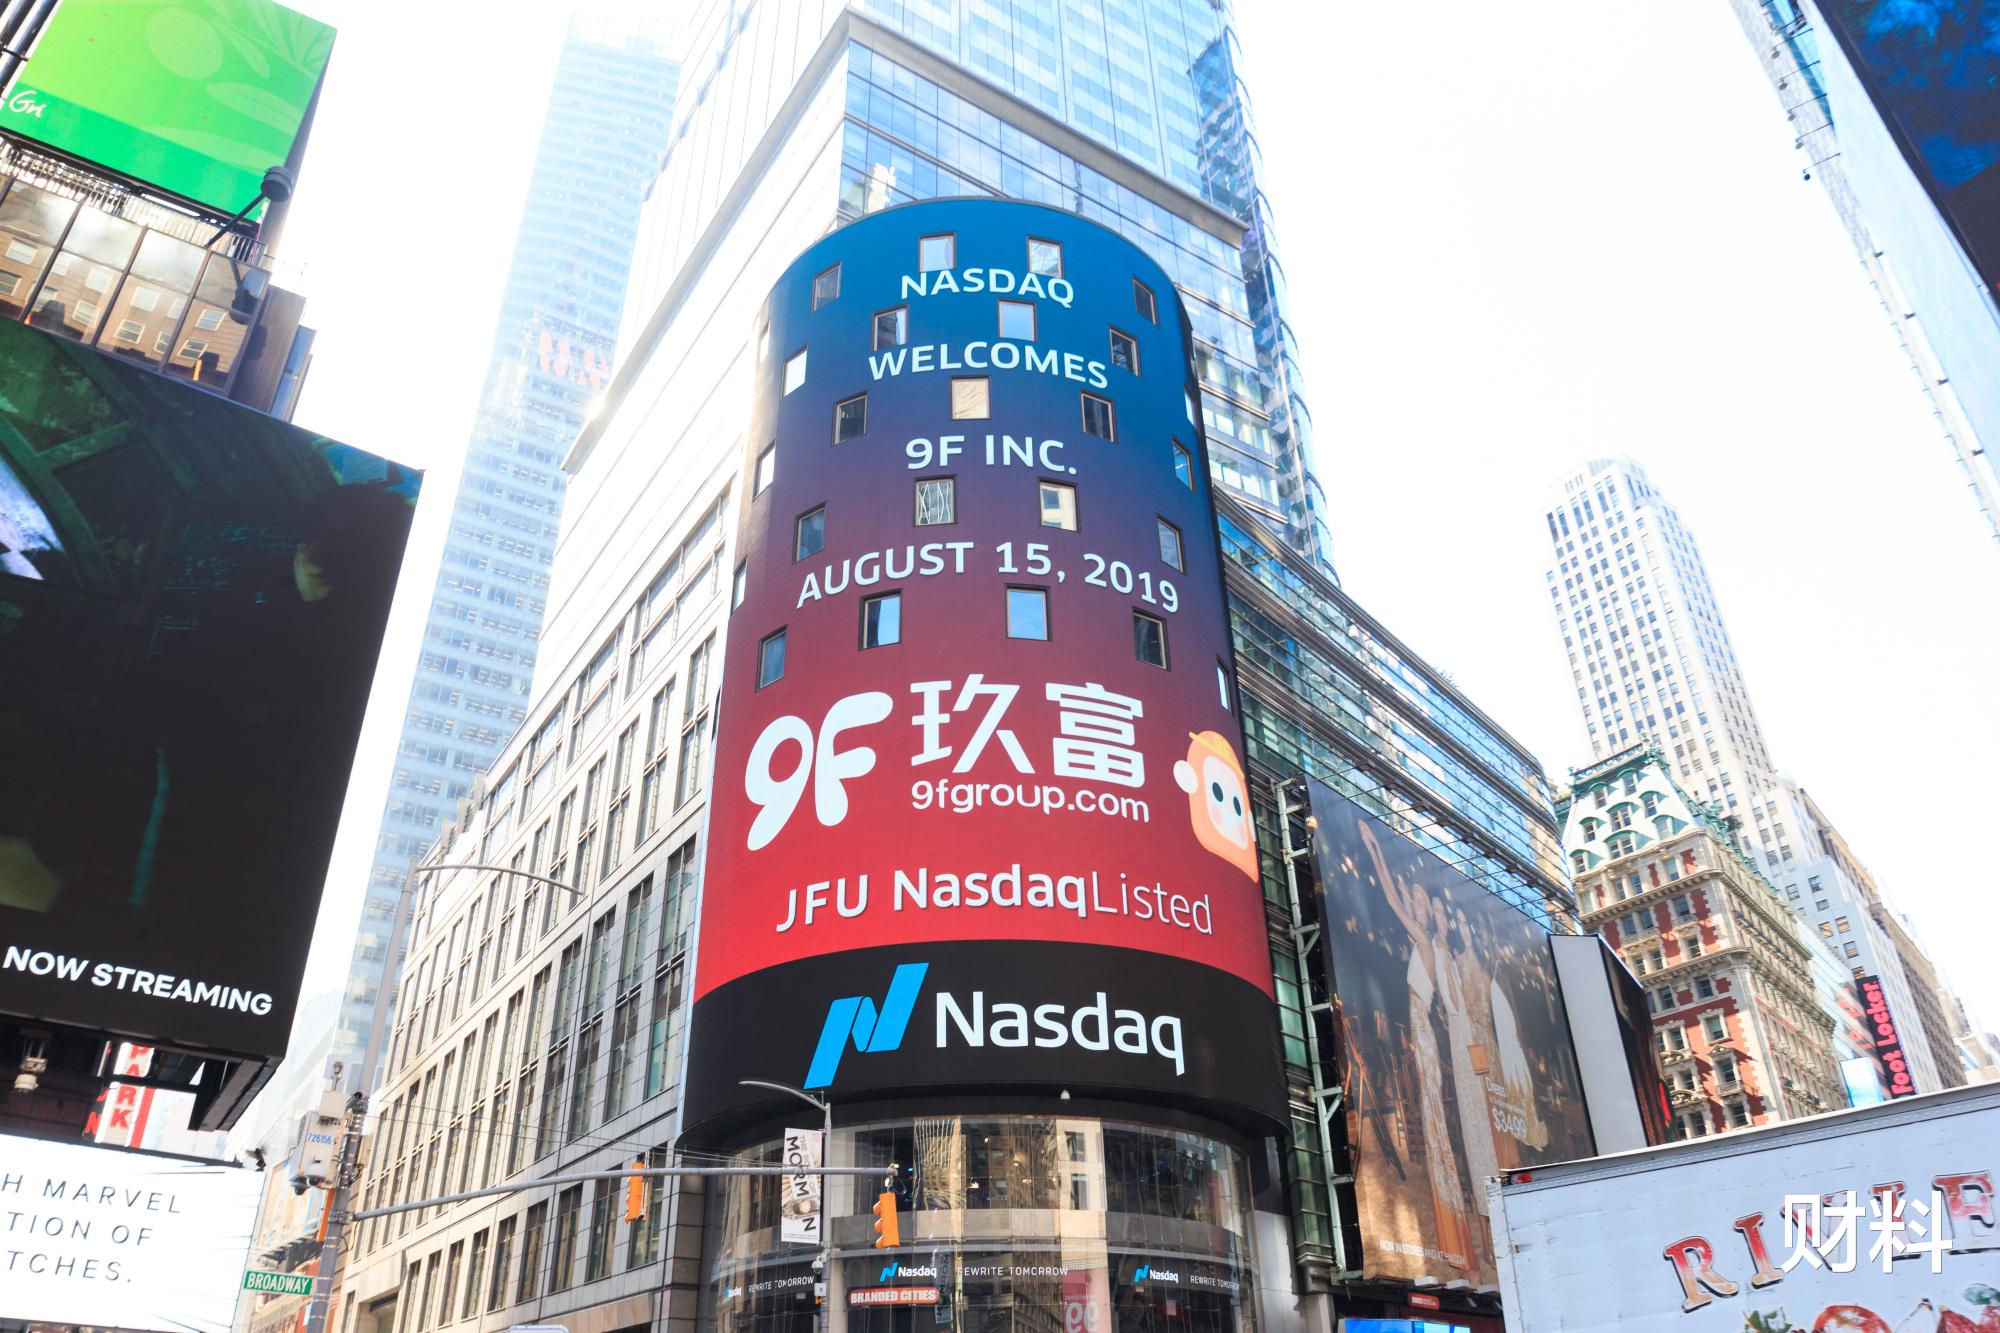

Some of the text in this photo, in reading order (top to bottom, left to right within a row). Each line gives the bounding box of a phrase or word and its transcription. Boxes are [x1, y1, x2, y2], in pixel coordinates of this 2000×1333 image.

[900, 267, 1075, 308] NASDAQ
[868, 341, 1109, 389] WELCOMES
[905, 434, 1078, 475] 9F INC.
[796, 541, 1179, 613] AUGUST 15, 2019
[909, 673, 1146, 788] 玖富
[911, 778, 1150, 823] 9fgroup.com
[776, 874, 868, 933] JFU
[2, 945, 273, 1016] NOW STREAMING
[936, 991, 1187, 1077] Nasdaq
[1862, 981, 1914, 1095] Foot Locker
[43, 1178, 181, 1214] MARVEL
[8, 1211, 153, 1246] TION OF
[8, 1250, 132, 1283] TCHES.
[246, 1272, 310, 1294] BROADWAY
[898, 1265, 937, 1279] Nasdaq
[1149, 1269, 1179, 1284] Nasdaq
[850, 1289, 937, 1304] BRANDED CITIES
